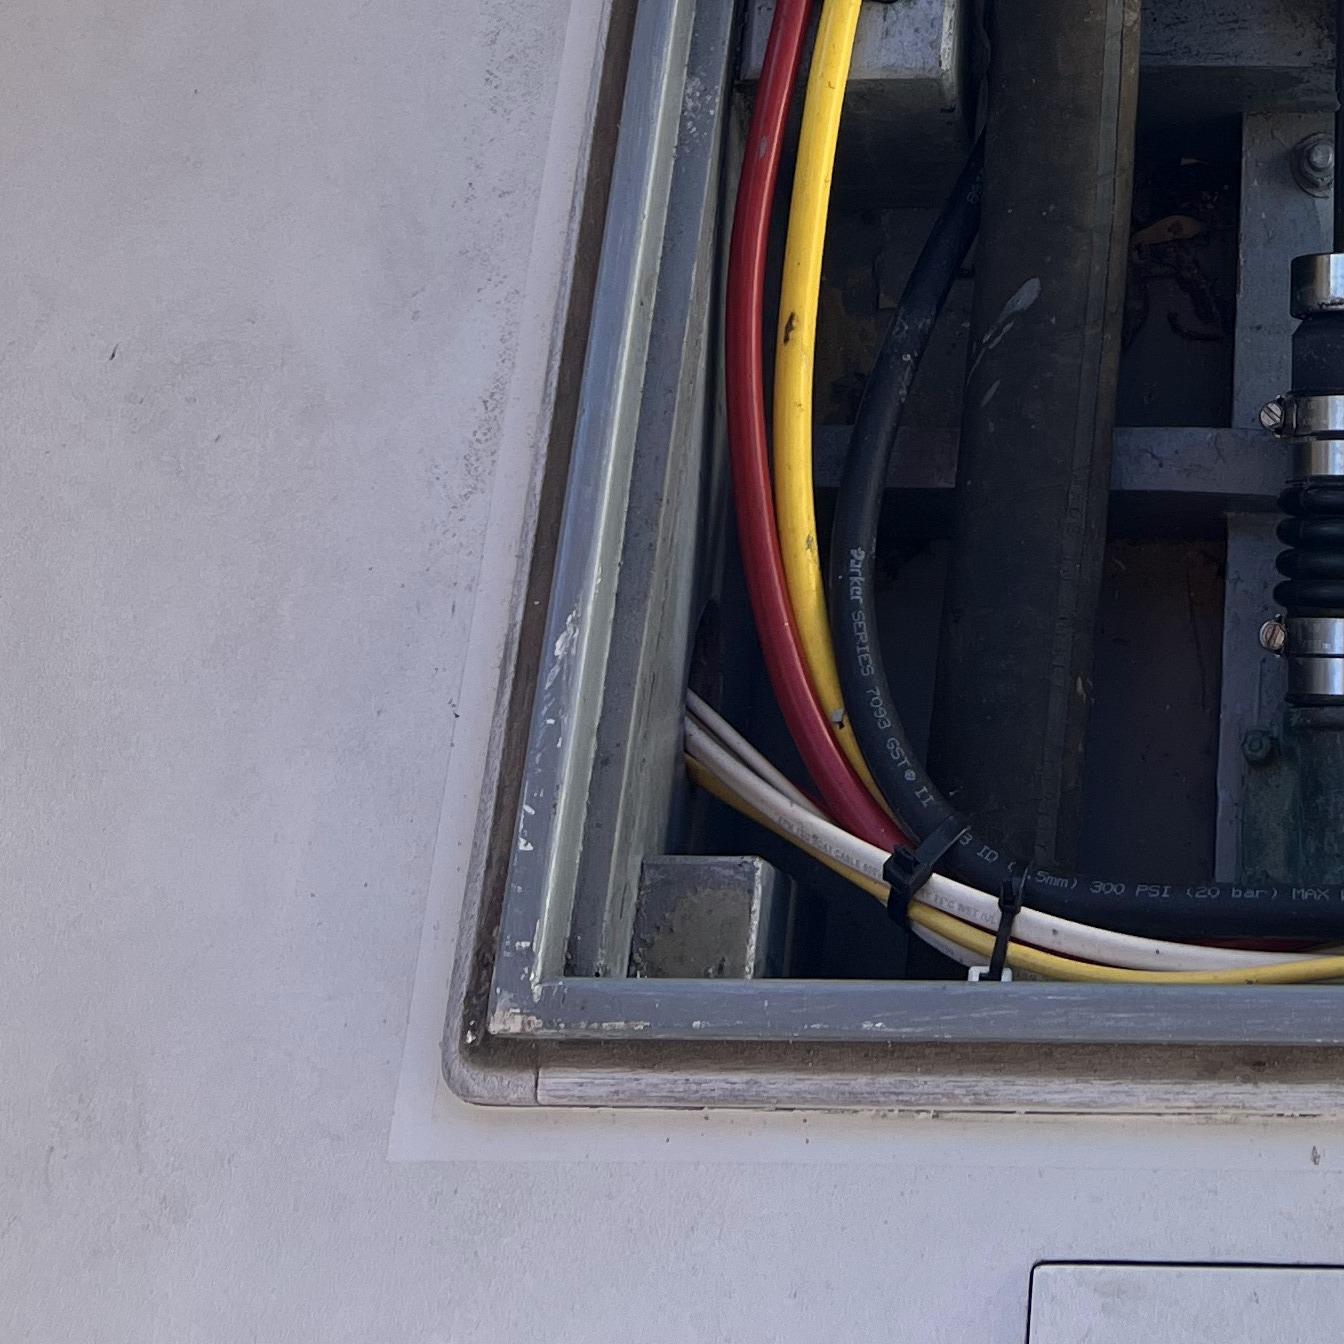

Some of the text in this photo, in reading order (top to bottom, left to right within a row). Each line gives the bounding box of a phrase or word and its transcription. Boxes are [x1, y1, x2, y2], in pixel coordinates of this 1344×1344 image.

[850, 610, 875, 677] SERIES
[866, 685, 892, 730] 7093
[976, 845, 999, 864] ID
[1089, 881, 1126, 896] 300
[1135, 884, 1172, 899] PSI
[1185, 886, 1221, 900] (20
[1231, 885, 1279, 900] bar)
[1292, 887, 1331, 902] MAX
